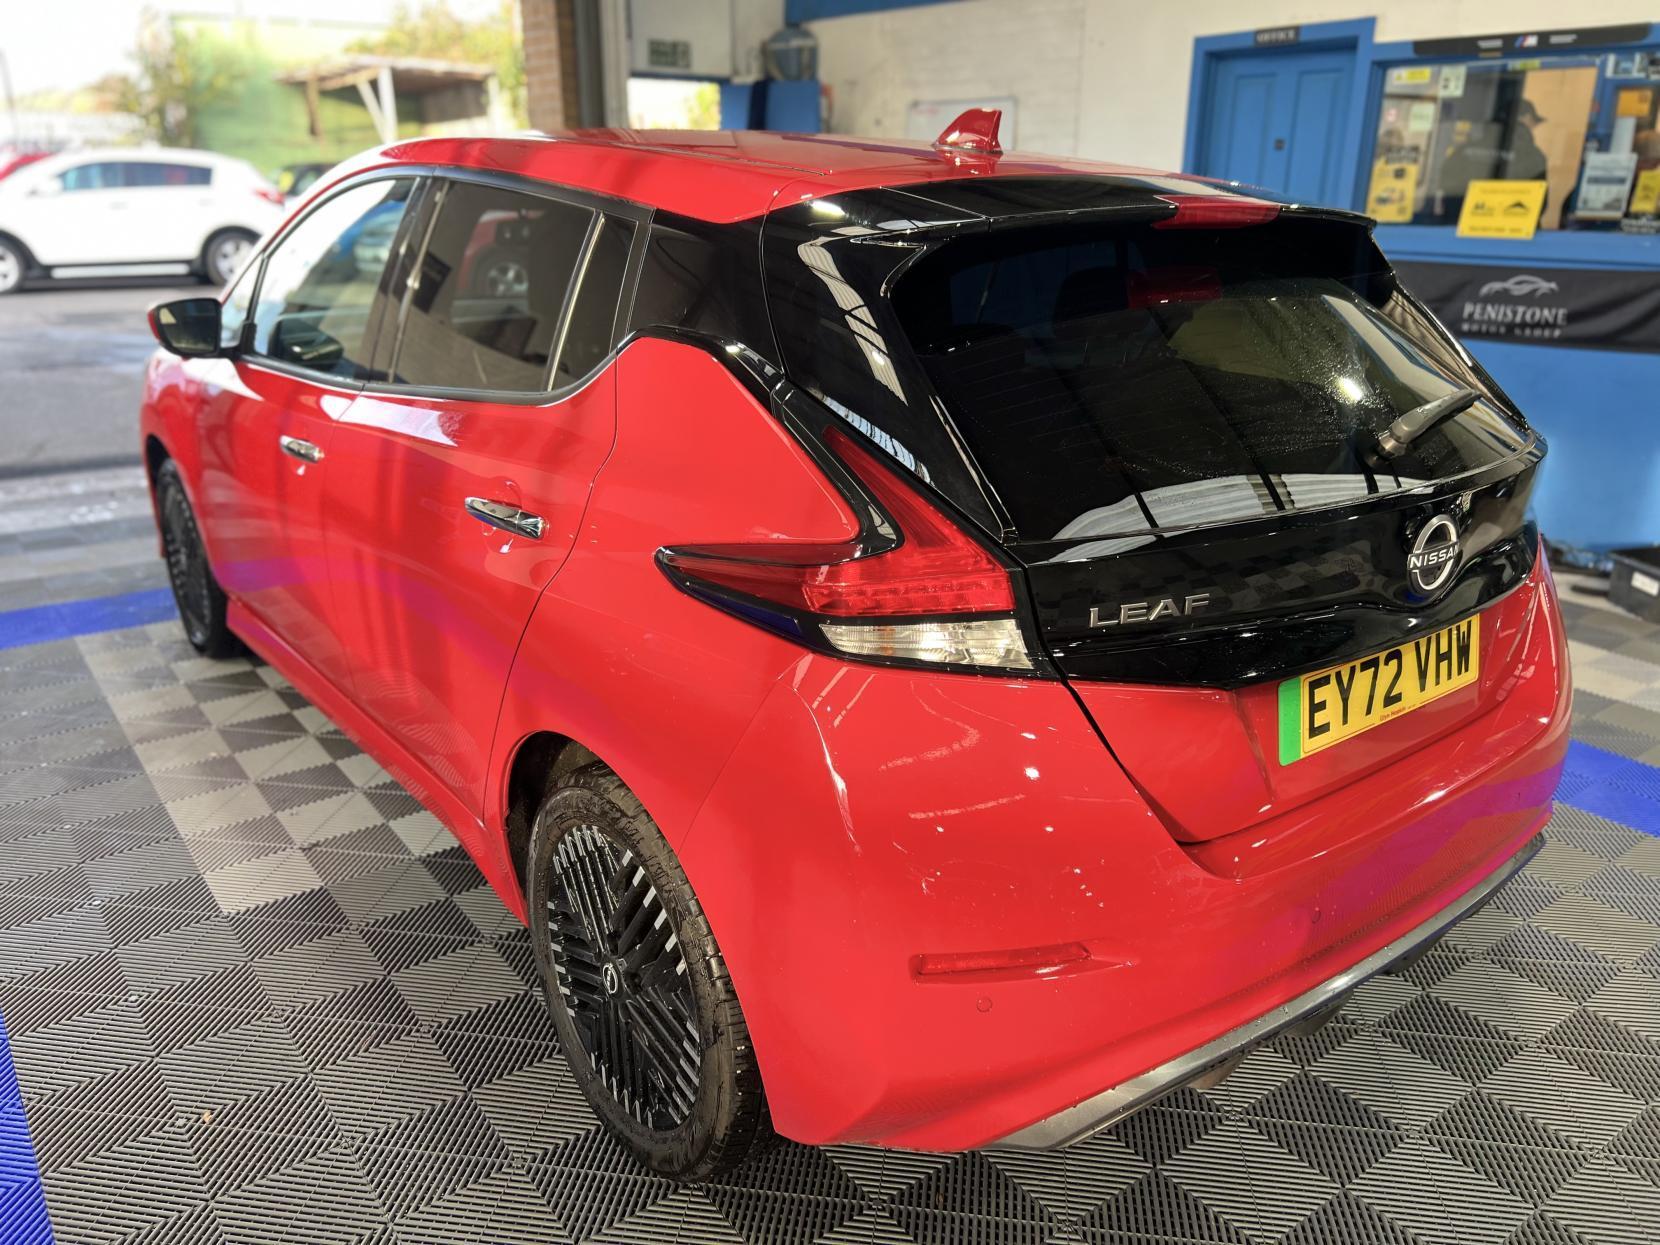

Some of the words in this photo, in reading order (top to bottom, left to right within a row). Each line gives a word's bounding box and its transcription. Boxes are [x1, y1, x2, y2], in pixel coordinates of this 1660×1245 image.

[1462, 301, 1568, 326] PENISTONE
[1409, 545, 1460, 569] NISSAN
[1089, 593, 1211, 629] LEAF
[1308, 649, 1403, 740] EY72
[1415, 620, 1473, 694] VHW
